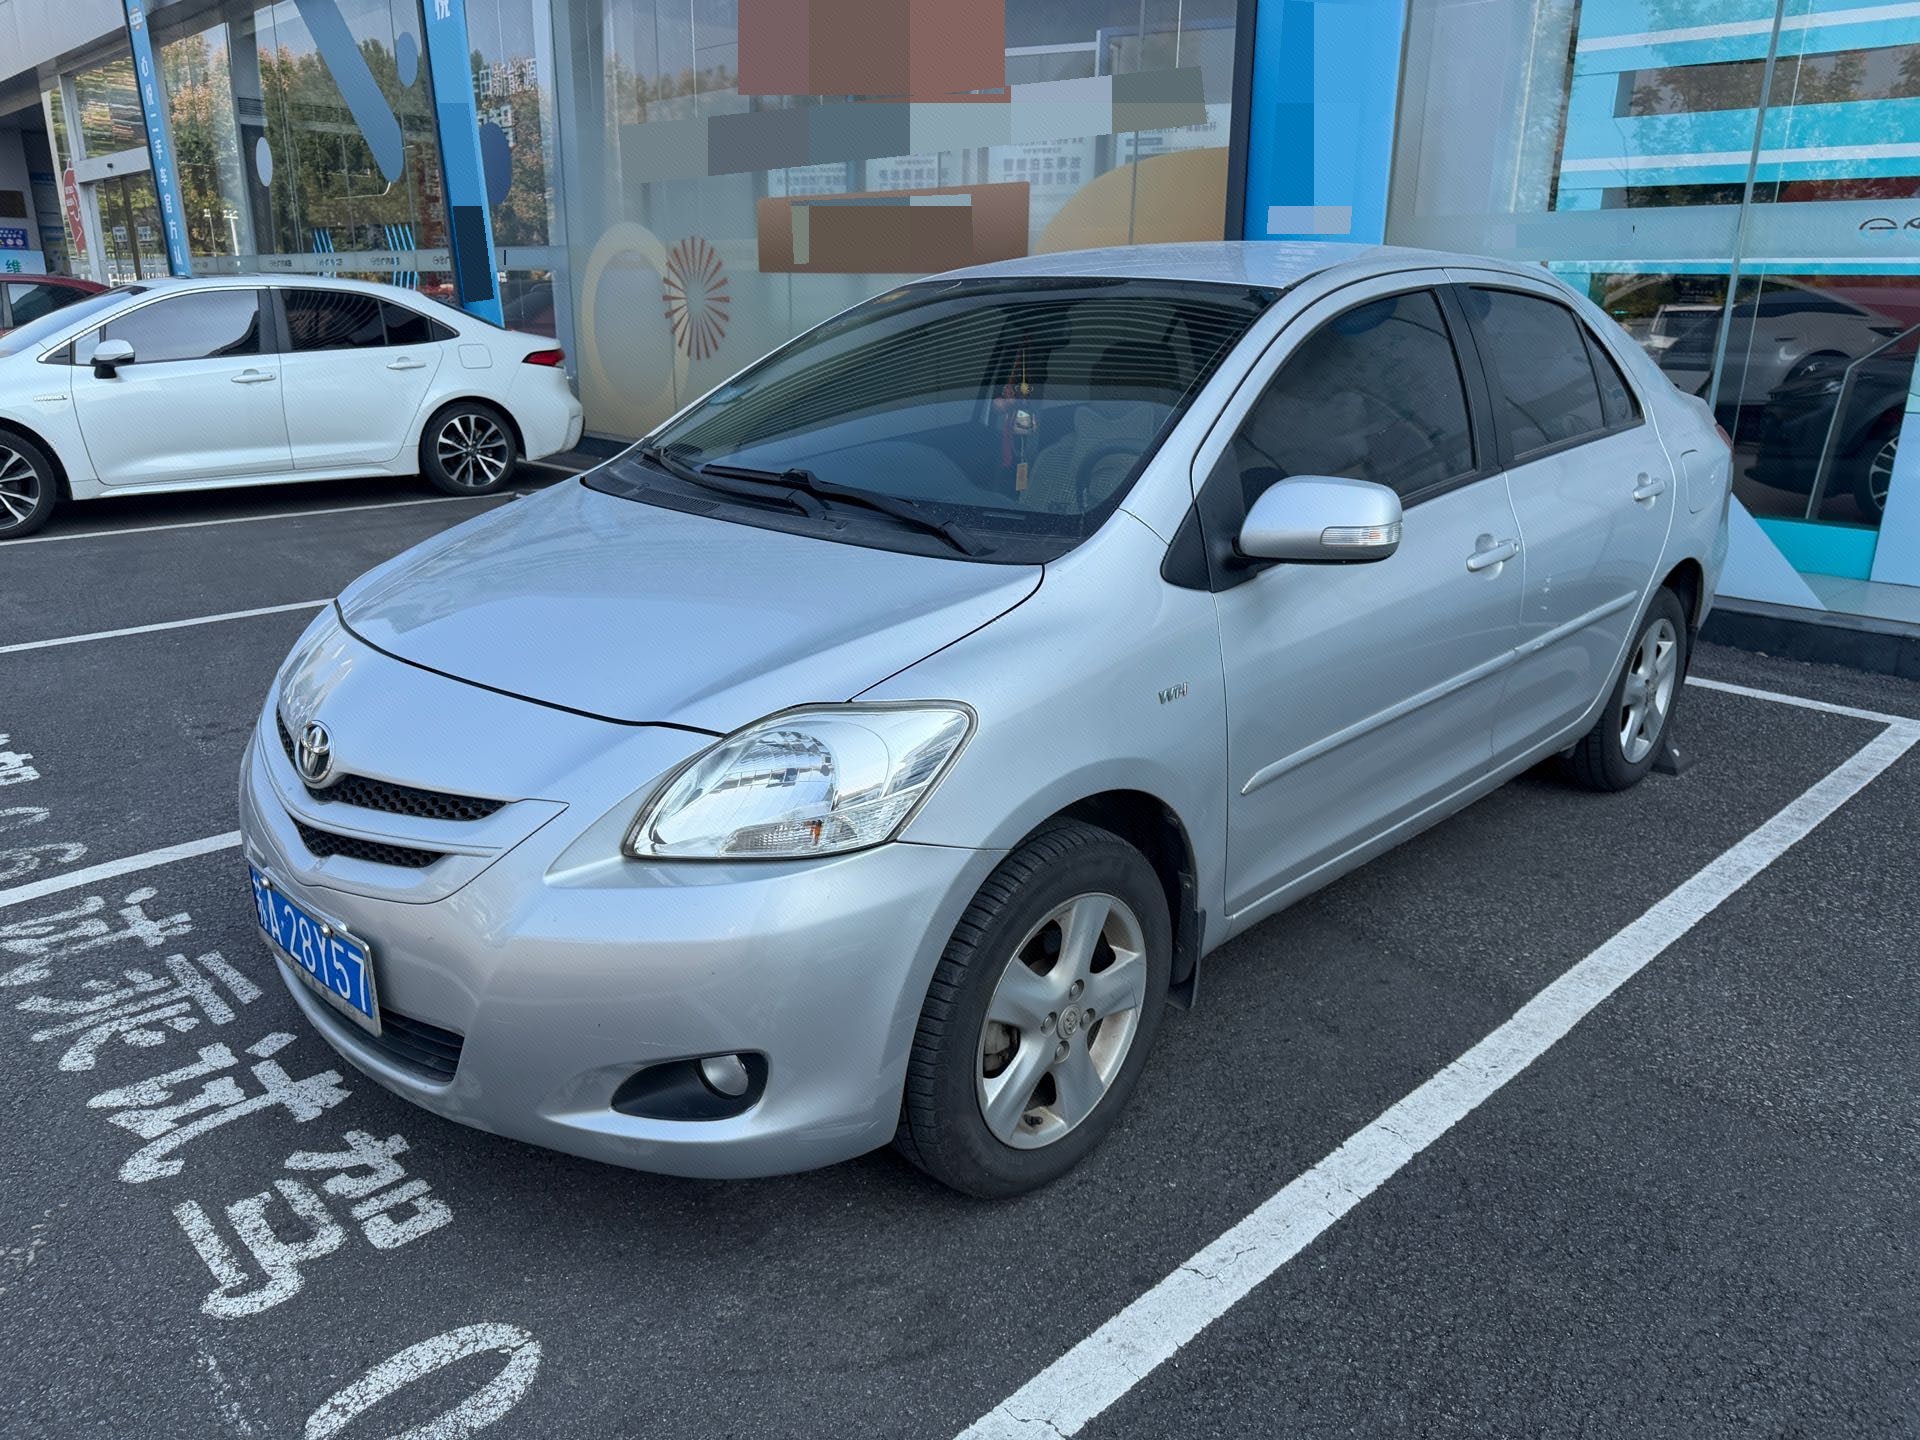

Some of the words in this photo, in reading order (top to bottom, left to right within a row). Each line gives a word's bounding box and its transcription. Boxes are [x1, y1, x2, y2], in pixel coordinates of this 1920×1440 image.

[140, 56, 186, 276] 心悦二手车官方认
